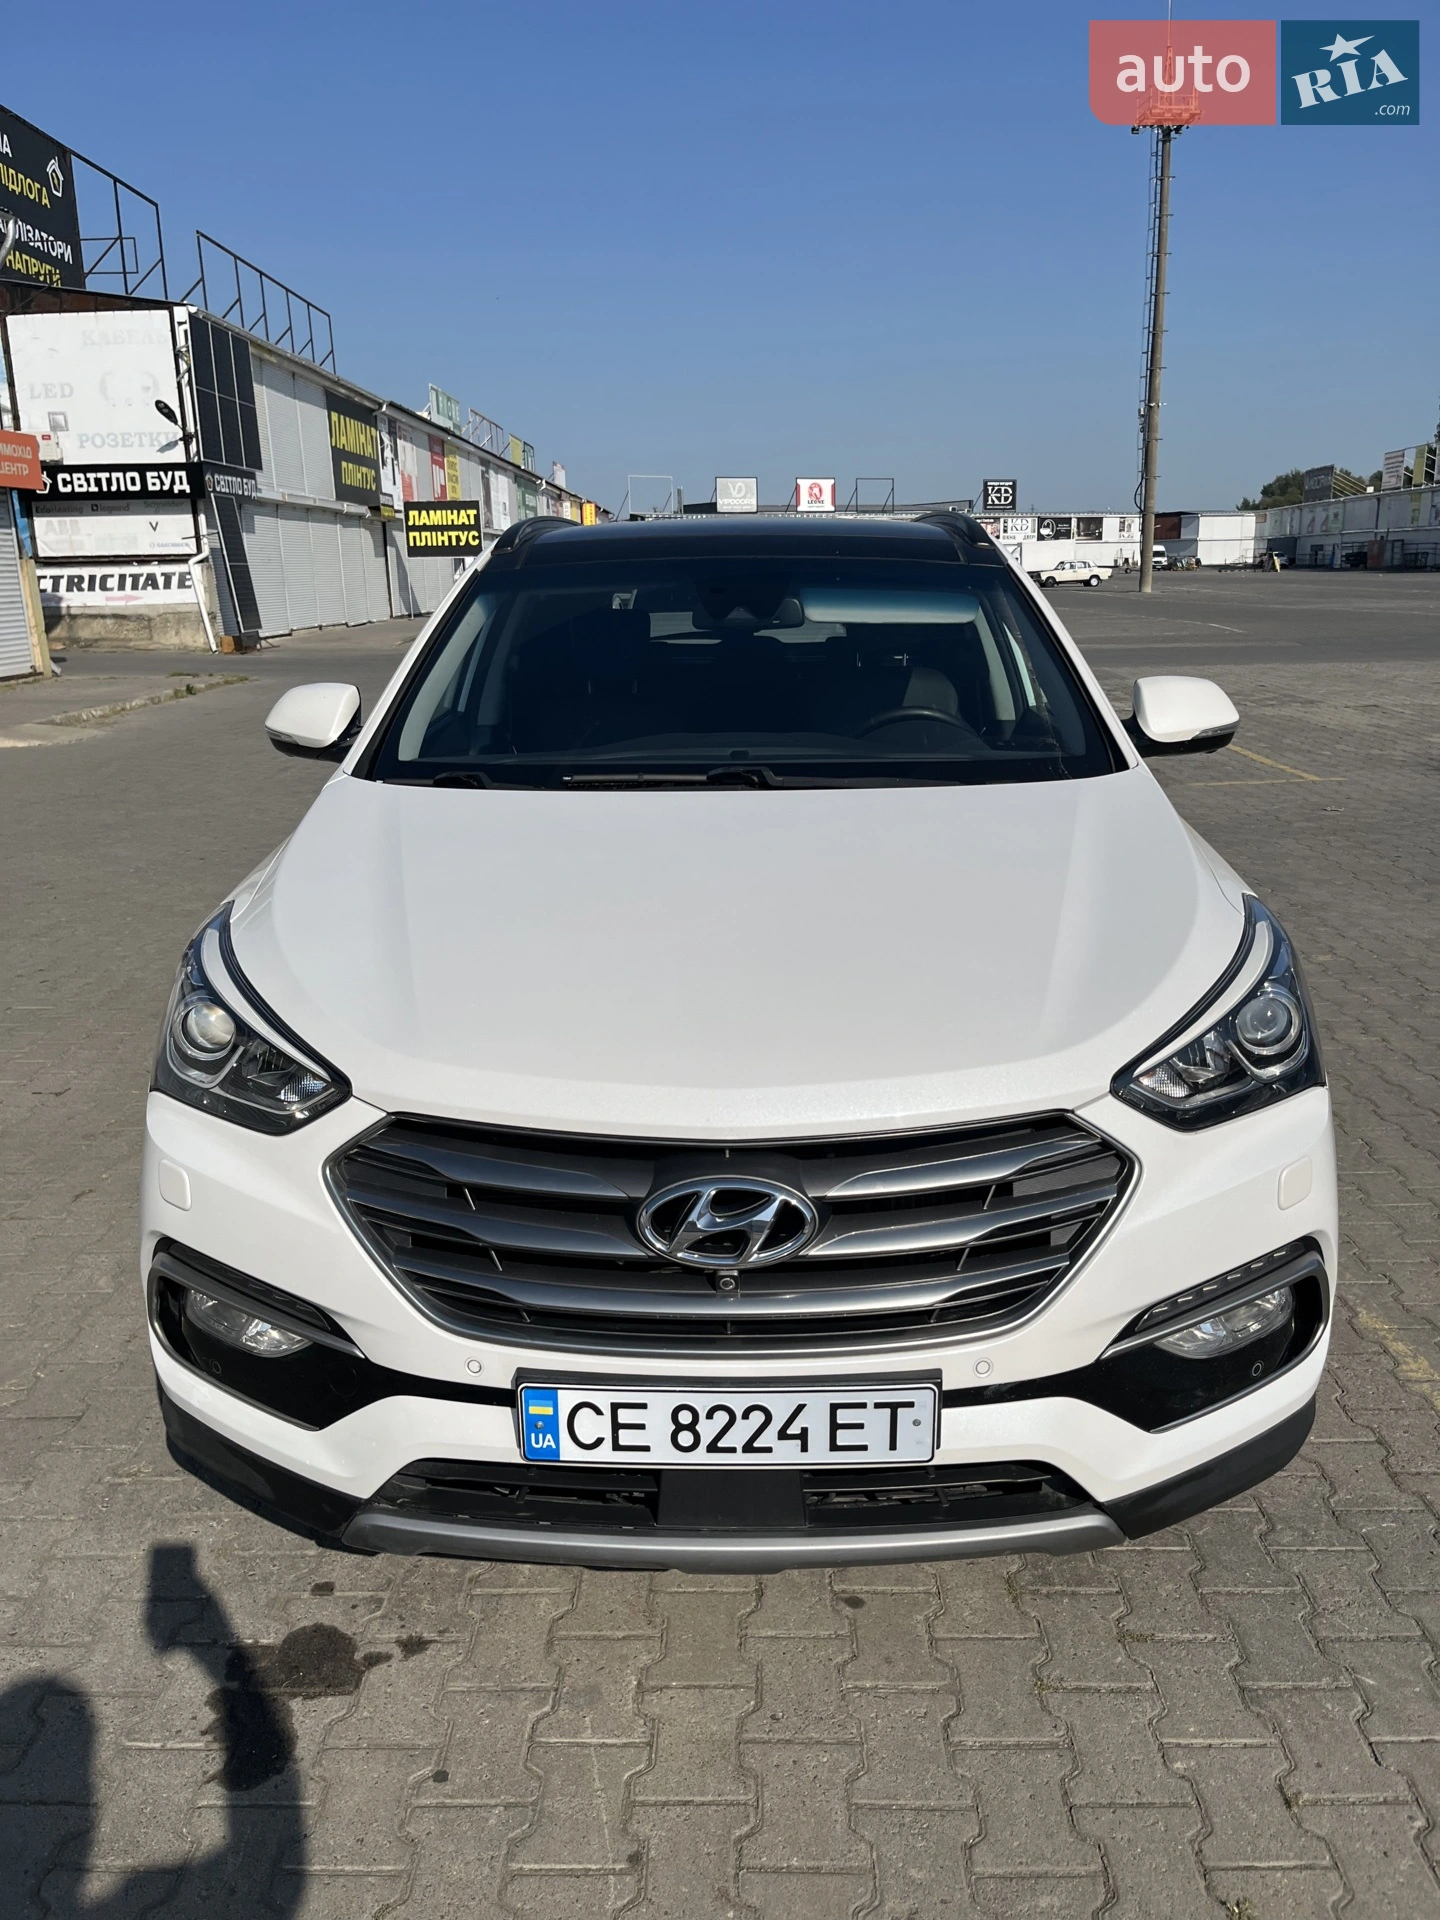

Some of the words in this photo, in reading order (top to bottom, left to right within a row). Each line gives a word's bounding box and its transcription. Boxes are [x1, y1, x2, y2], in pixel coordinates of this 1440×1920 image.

[28, 382, 74, 400] LED
[330, 411, 377, 460] ЛАМІНАТ
[57, 471, 142, 493] СВІТЛО
[146, 470, 191, 494] БУД
[214, 473, 243, 495] СВІТЛО
[242, 477, 258, 500] БУД
[341, 461, 377, 491] ПЛІНТУС
[408, 510, 477, 527] ЛАМІНАТ
[409, 531, 479, 547] ПЛІНТУС
[566, 1401, 651, 1452] CE
[670, 1403, 809, 1453] 8224
[829, 1402, 915, 1452] ET
[531, 1433, 556, 1449] UA
